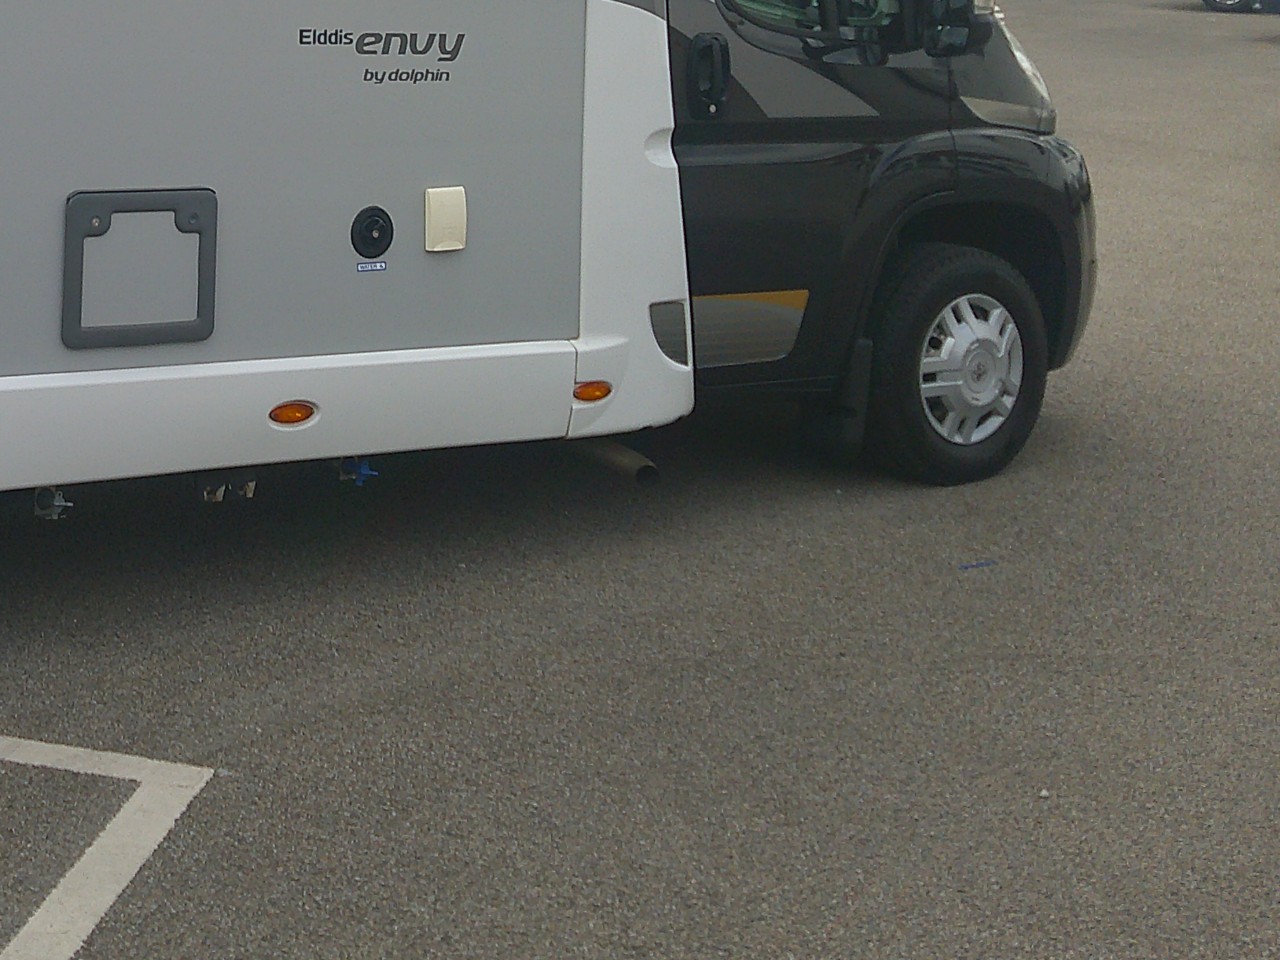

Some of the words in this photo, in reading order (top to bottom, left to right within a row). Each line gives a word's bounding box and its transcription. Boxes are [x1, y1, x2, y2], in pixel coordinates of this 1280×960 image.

[298, 28, 354, 45] Elddis
[355, 32, 466, 62] envy
[363, 69, 386, 84] by
[387, 69, 451, 84] dolphin
